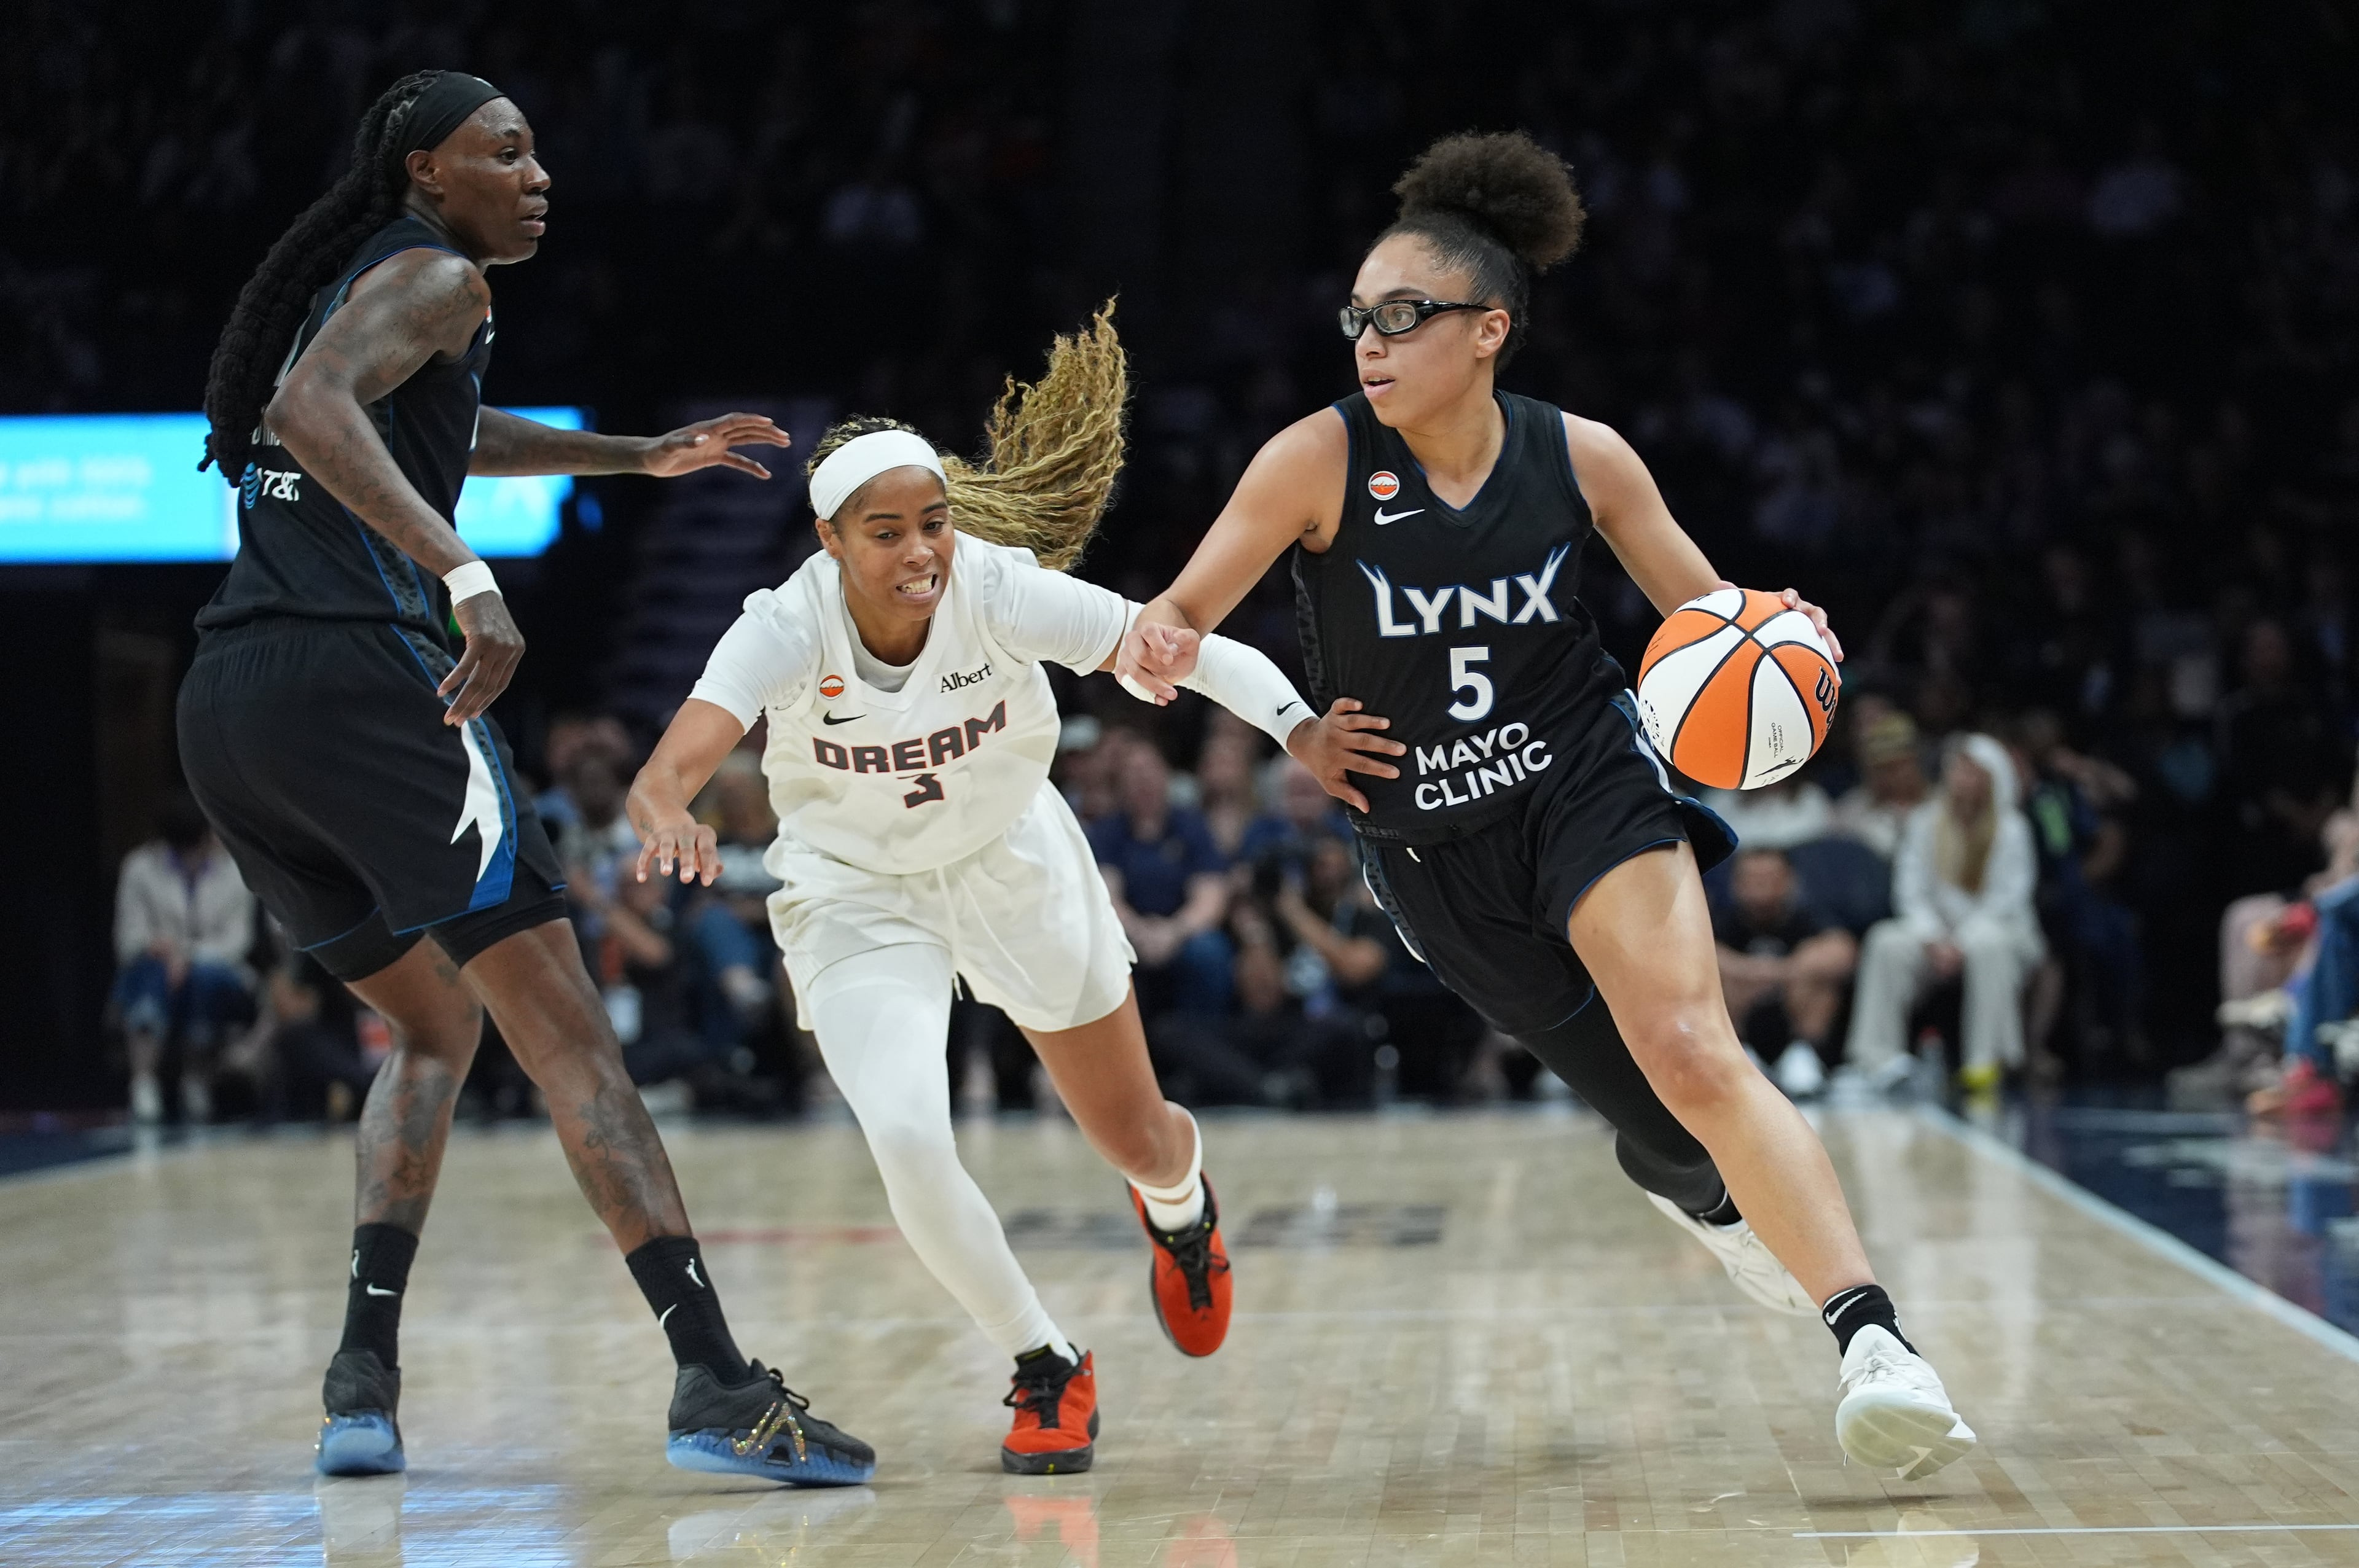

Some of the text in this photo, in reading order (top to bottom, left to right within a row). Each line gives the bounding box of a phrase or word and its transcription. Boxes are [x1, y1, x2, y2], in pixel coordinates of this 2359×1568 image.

[1355, 542, 1571, 638] LYNX
[940, 663, 993, 693] Albert
[1446, 645, 1495, 723] 5
[813, 699, 1007, 774] DREAM
[1415, 722, 1530, 776] MAYO
[896, 773, 945, 809] 3
[1415, 741, 1553, 811] CLINIC
